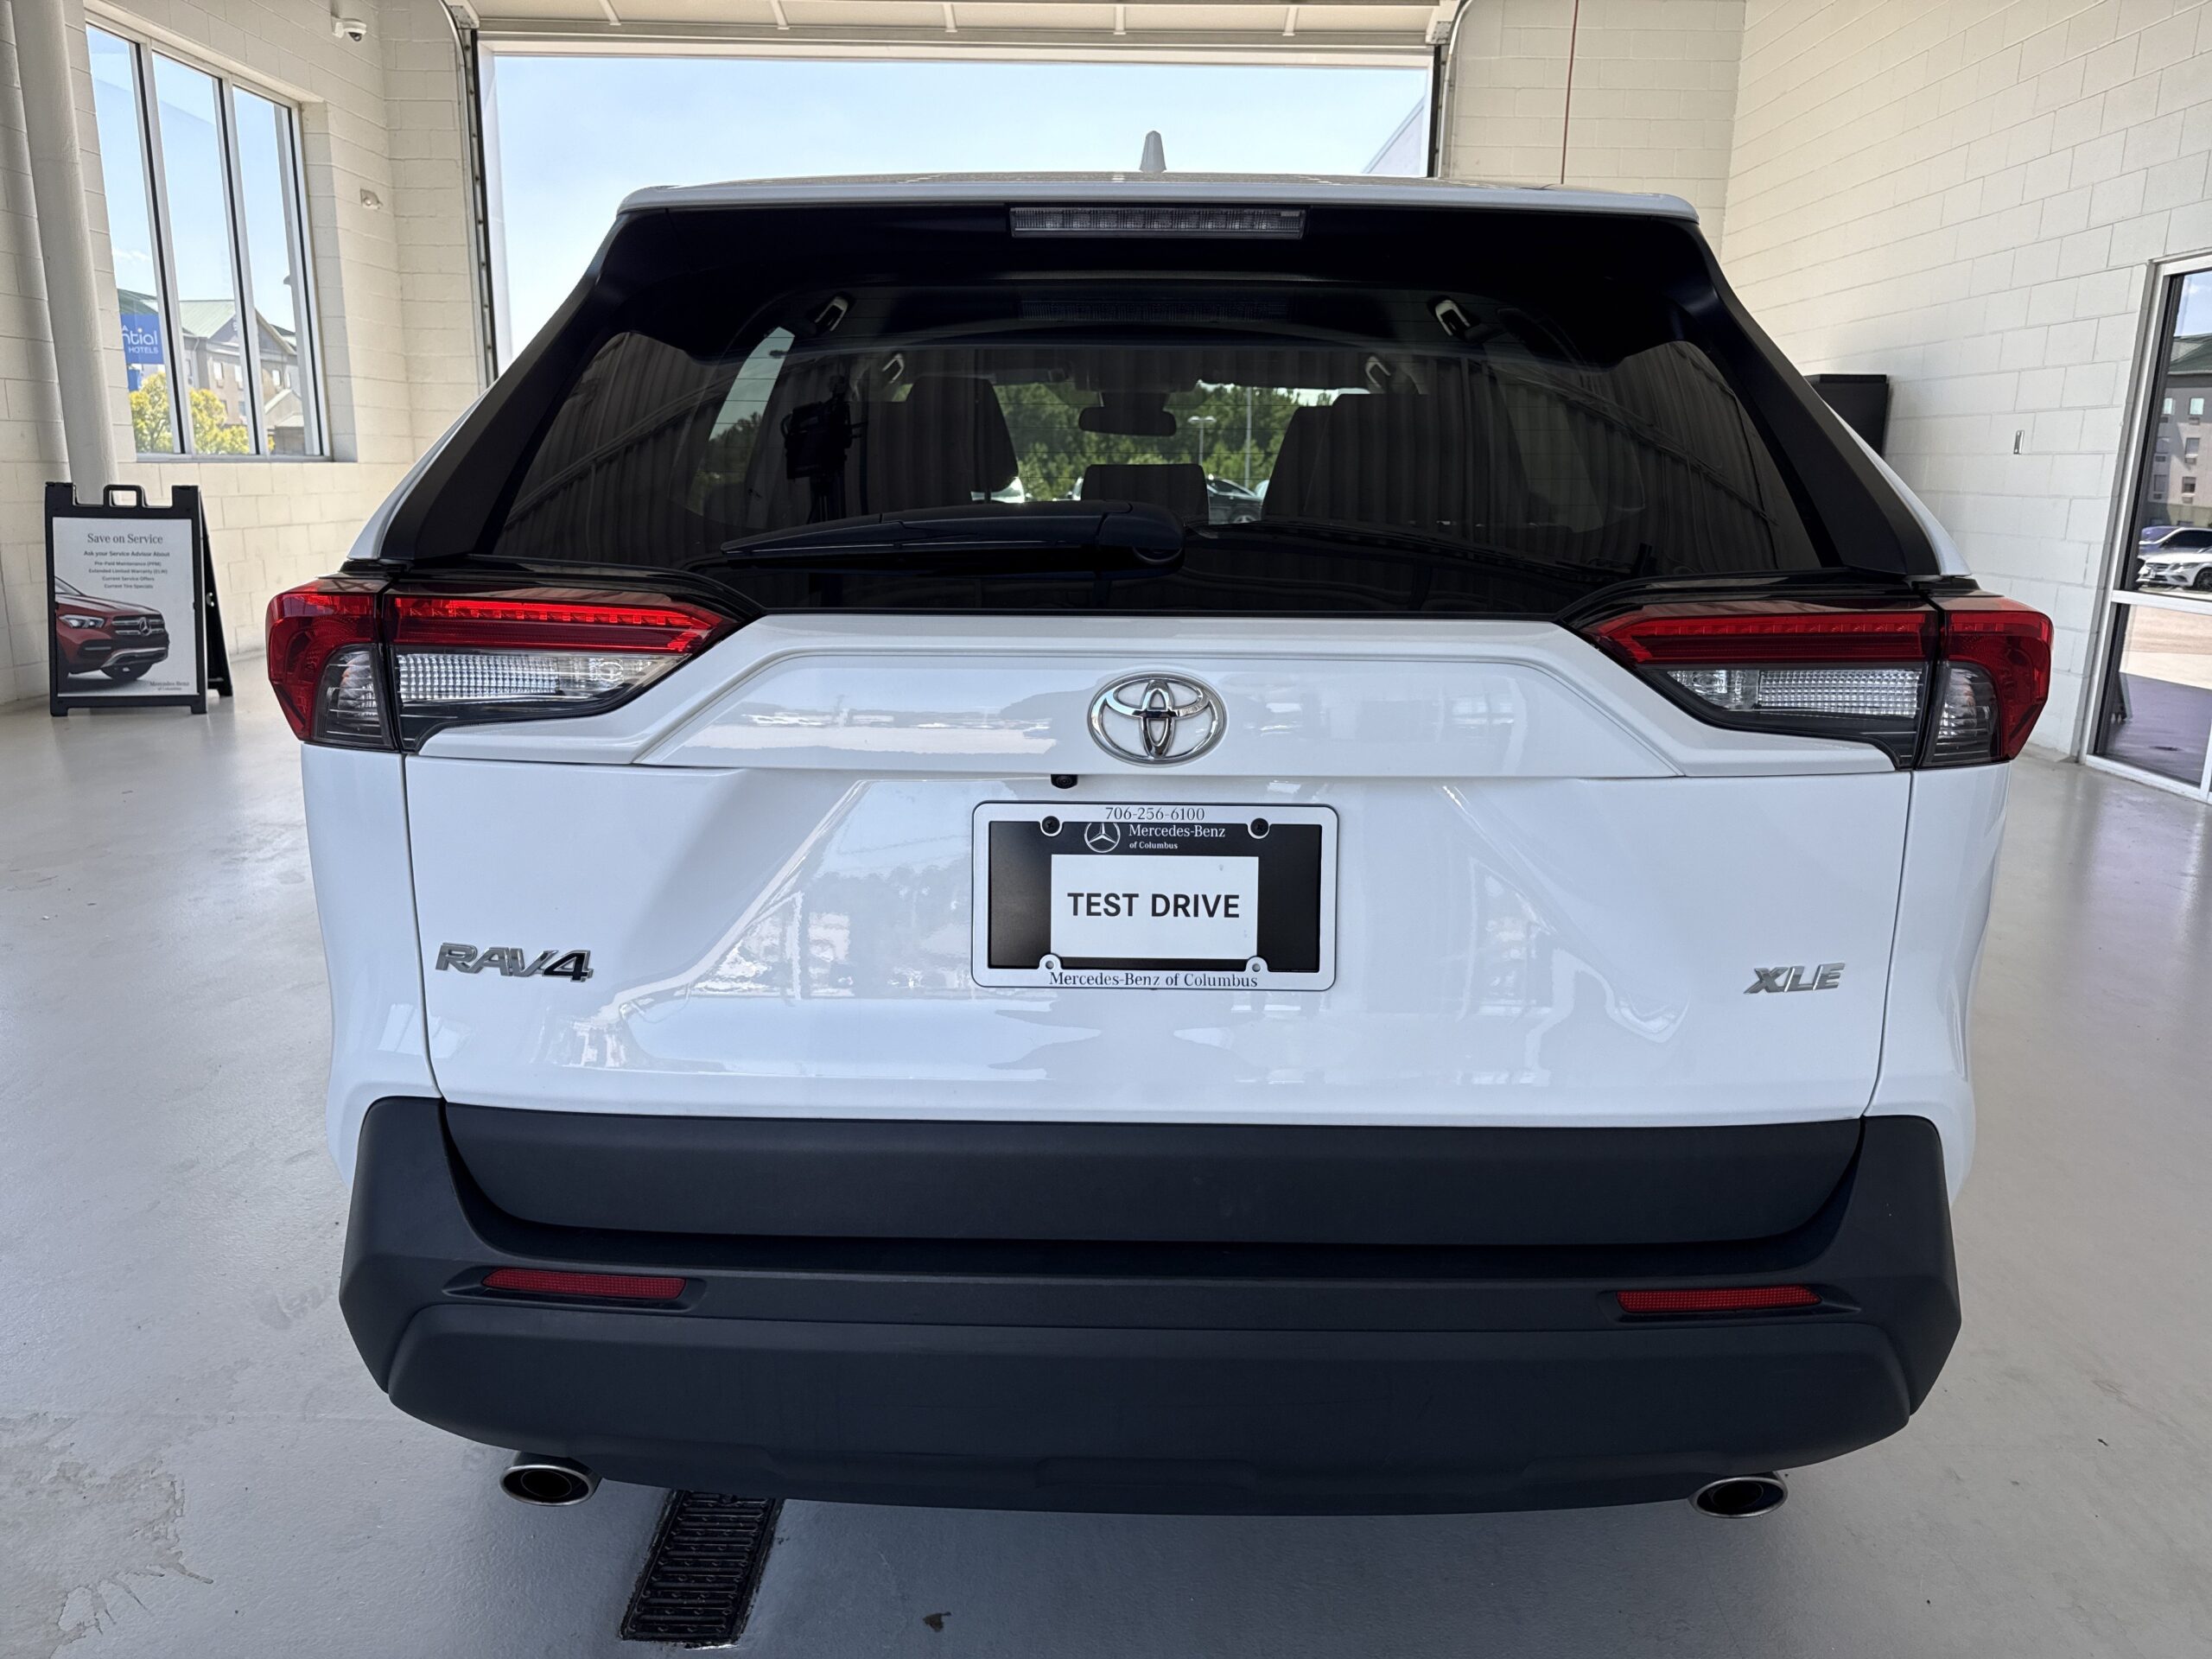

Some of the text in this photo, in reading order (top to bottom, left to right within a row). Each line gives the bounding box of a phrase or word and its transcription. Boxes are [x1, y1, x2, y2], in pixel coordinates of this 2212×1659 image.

[87, 533, 163, 544] Save on Service
[1105, 807, 1205, 821] 706-256-6100
[1128, 823, 1226, 837] Mercedes-Benz
[1129, 841, 1179, 849] of Columbus
[1067, 893, 1240, 918] TEST DRIVE
[435, 942, 594, 982] RAV4
[1049, 971, 1258, 988] Mercedes-Benz of Columbus
[1743, 962, 1846, 995] XLE
